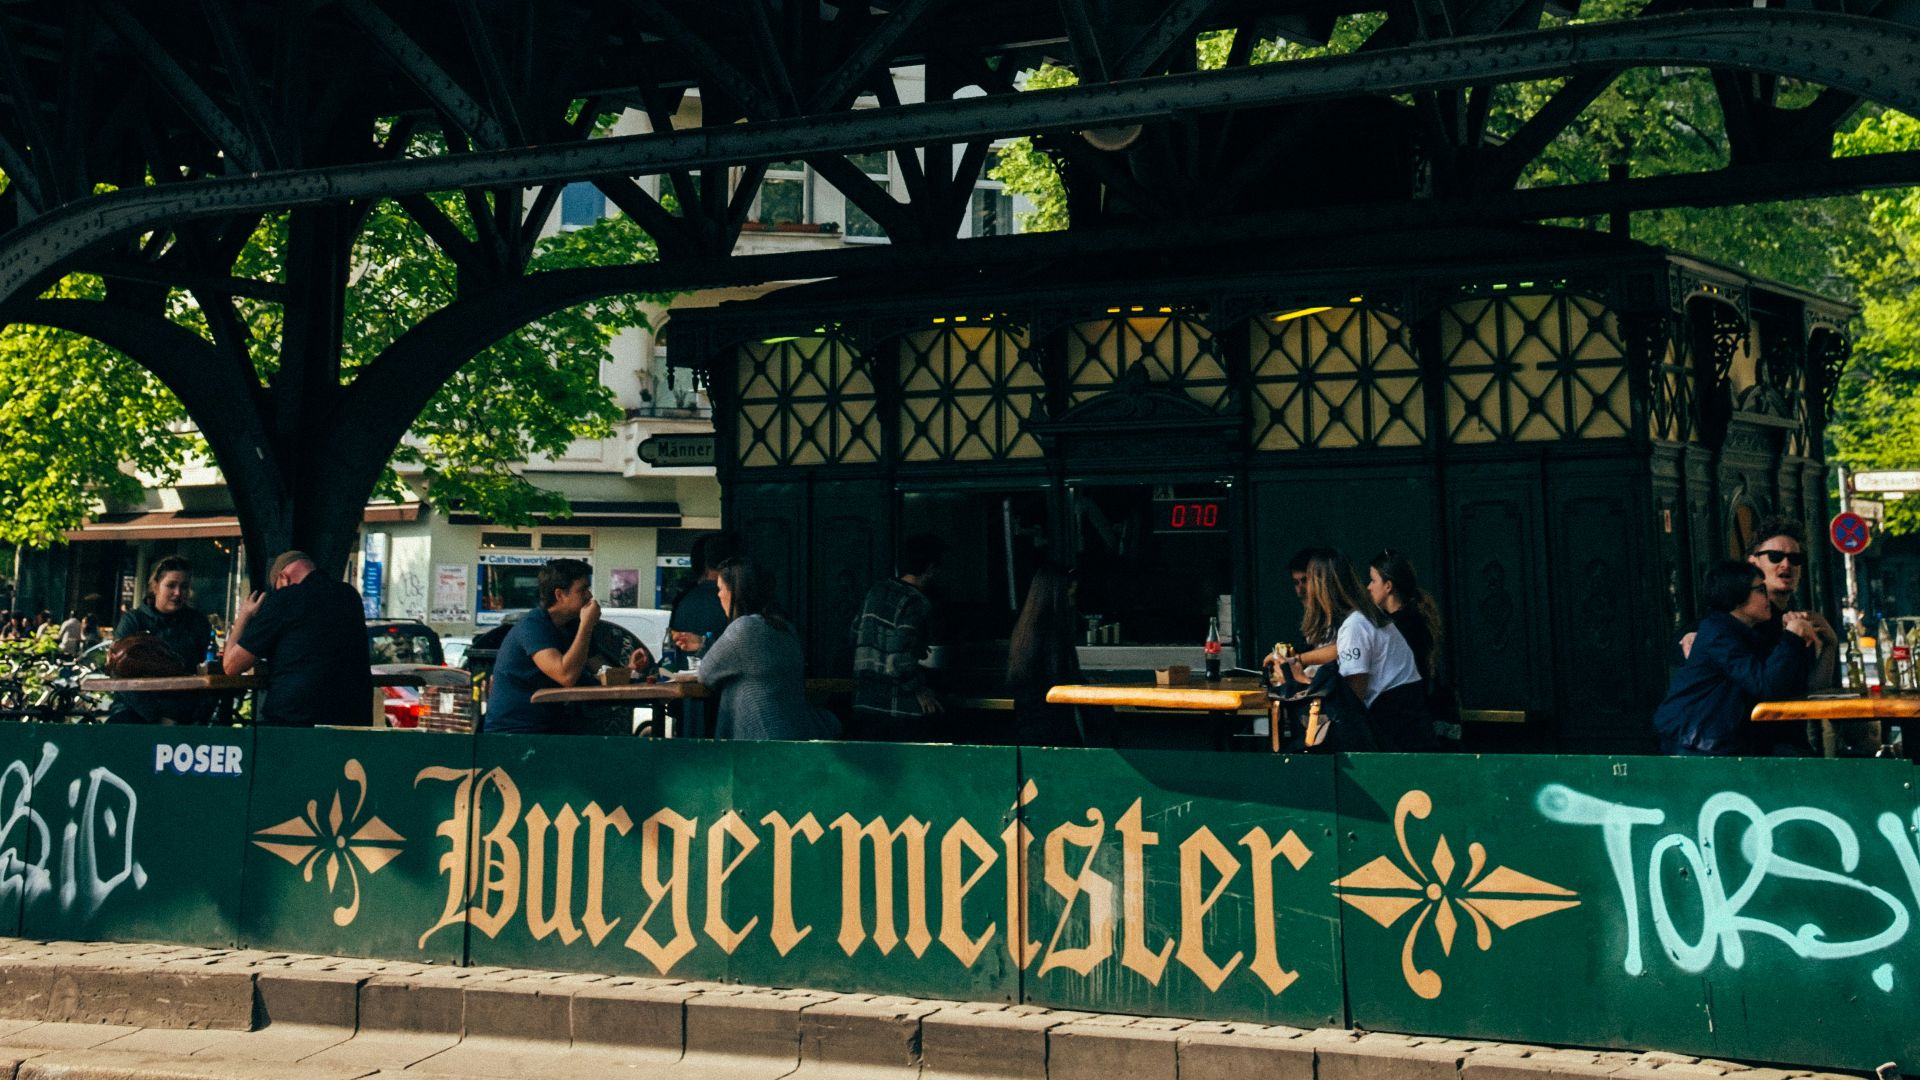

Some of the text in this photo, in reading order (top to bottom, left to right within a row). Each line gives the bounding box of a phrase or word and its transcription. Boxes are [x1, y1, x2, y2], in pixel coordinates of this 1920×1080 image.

[658, 440, 712, 458] Männer
[1171, 504, 1219, 528] 070
[489, 553, 505, 563] Call
[507, 554, 521, 564] the
[155, 743, 243, 776] POSER
[414, 766, 1312, 996] Burgermeister
